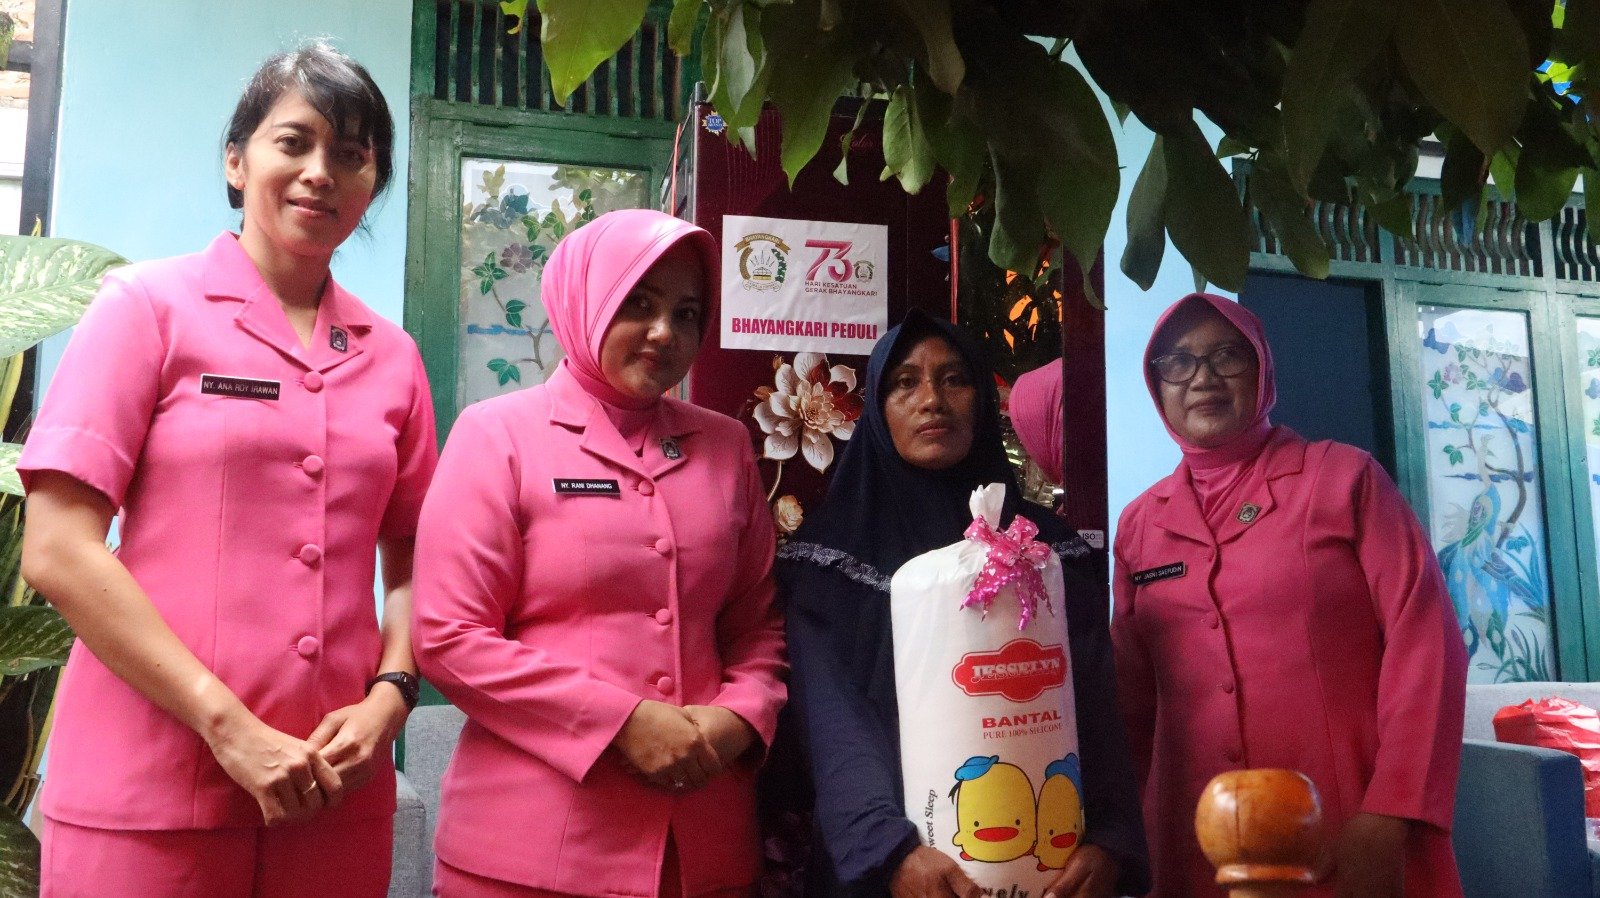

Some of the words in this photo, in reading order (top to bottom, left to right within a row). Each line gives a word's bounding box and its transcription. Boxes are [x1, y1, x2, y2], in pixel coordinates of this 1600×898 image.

[805, 239, 853, 282] 73
[828, 288, 878, 296] BHAYANGKARI
[732, 317, 828, 337] BHAYANGKARI
[831, 322, 877, 340] PEDULI
[217, 382, 233, 391] ANA
[250, 385, 278, 395] IRAWAN
[972, 657, 1060, 679] JESSELYN
[982, 710, 1061, 728] BANTAL
[983, 730, 1007, 739] PURE
[1009, 729, 1028, 738] 100%
[1029, 722, 1062, 735] SILICONE
[925, 789, 938, 818] Sleep
[927, 821, 936, 850] weet
